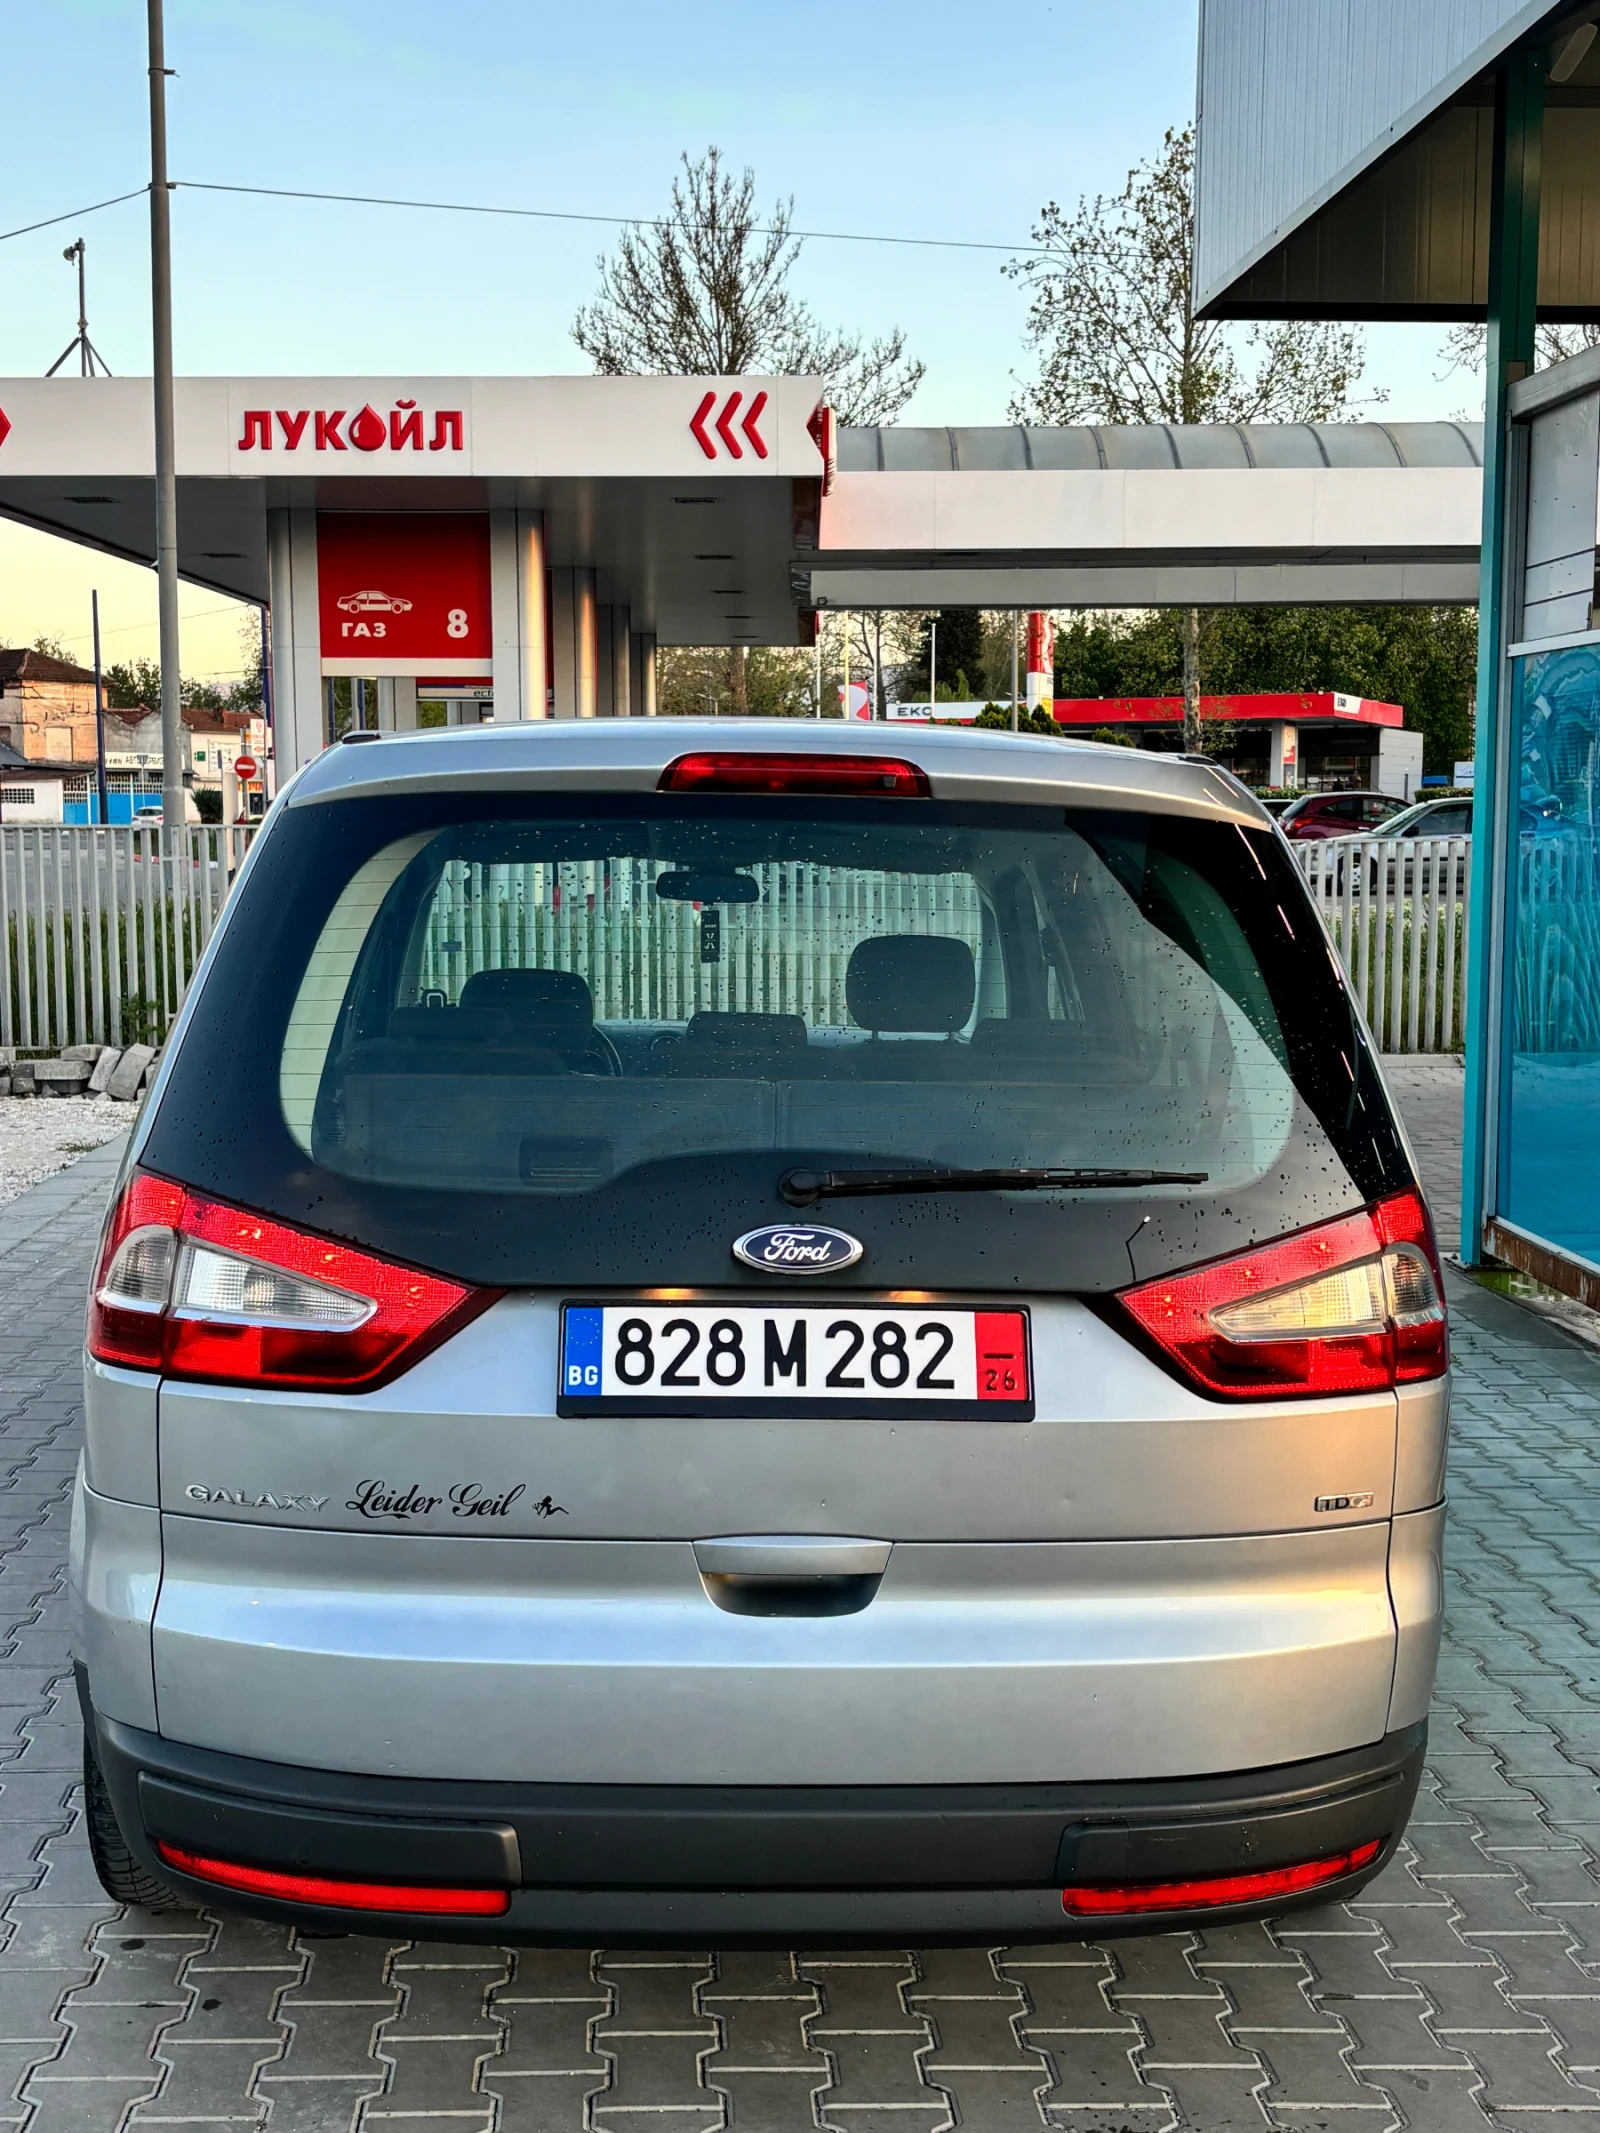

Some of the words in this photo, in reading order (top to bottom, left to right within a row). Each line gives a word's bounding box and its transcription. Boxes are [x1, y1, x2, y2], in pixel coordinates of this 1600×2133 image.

[342, 622, 386, 637] ГАЗ
[447, 608, 469, 638] 8
[764, 1234, 831, 1261] Ford
[615, 1318, 746, 1386] 828
[764, 1319, 806, 1386] M
[825, 1320, 954, 1389] 282
[568, 1366, 598, 1385] BG
[984, 1369, 1017, 1391] 26
[185, 1484, 329, 1512] GALAXY
[345, 1480, 442, 1519] Leider
[448, 1484, 526, 1516] Geil
